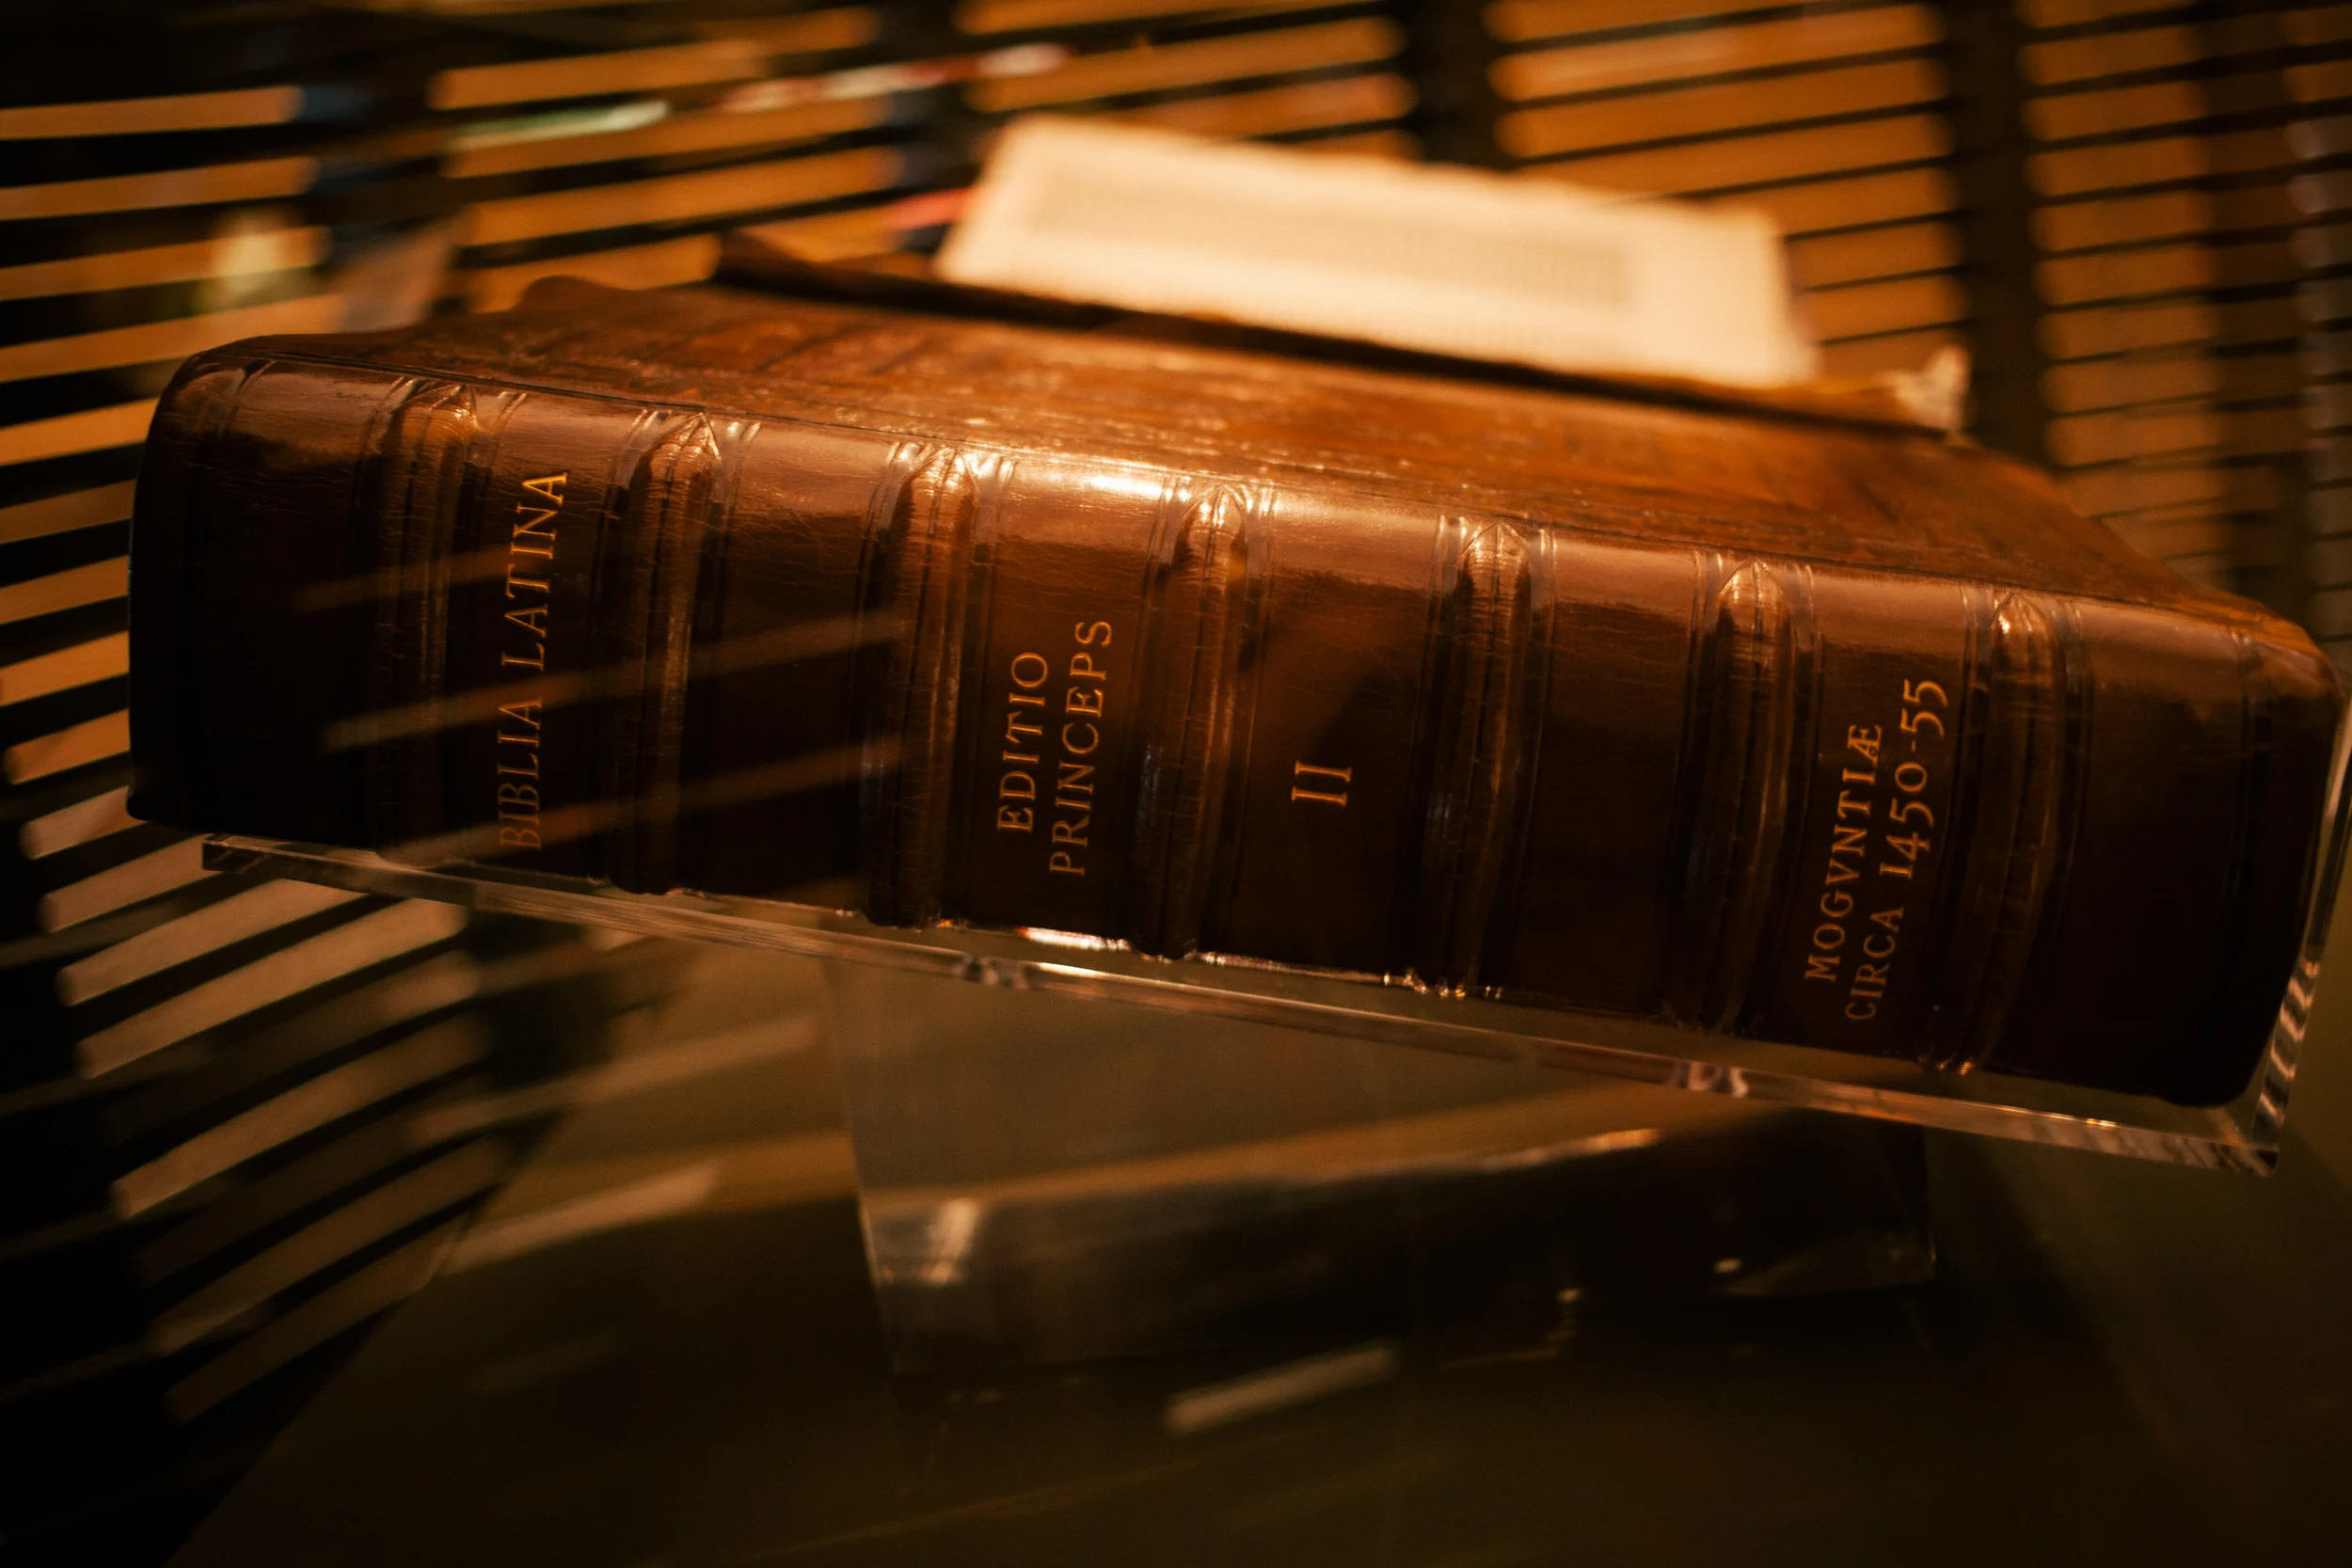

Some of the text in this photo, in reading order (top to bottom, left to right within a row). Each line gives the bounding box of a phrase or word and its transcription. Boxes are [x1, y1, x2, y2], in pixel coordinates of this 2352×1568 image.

[497, 471, 568, 850] BIBLIA LATINA
[996, 651, 1049, 832] EDITIO
[1049, 620, 1113, 877] PRINCEPS
[1290, 760, 1353, 808] II
[1844, 678, 1949, 1022] CIRCA 1450-55
